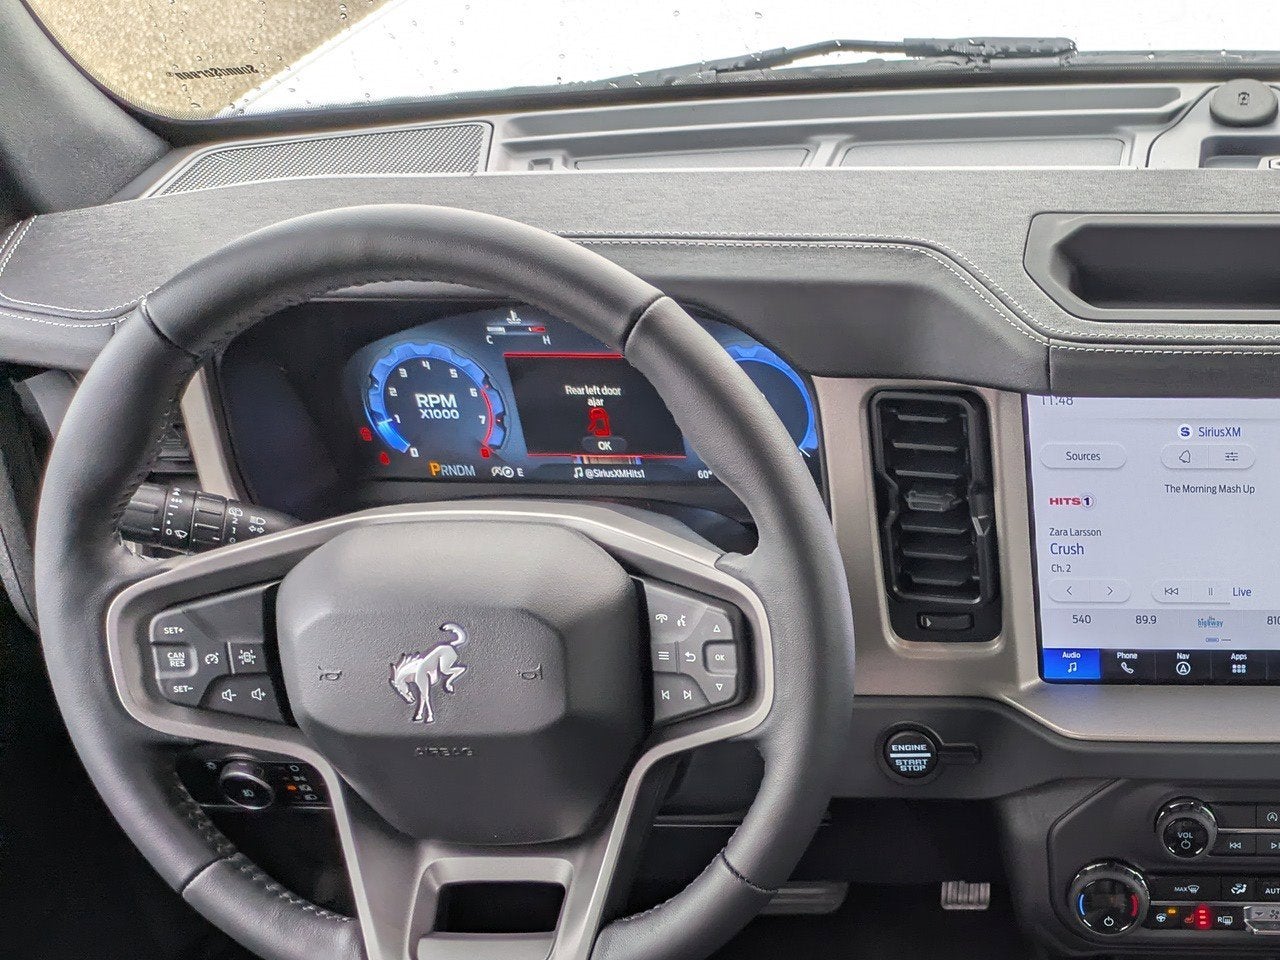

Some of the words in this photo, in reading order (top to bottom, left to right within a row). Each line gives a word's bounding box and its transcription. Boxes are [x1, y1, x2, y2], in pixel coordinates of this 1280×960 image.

[486, 335, 494, 345] C
[542, 335, 552, 345] H
[421, 360, 431, 370] 4
[399, 368, 408, 378] 3
[449, 368, 458, 378] 5
[388, 386, 398, 397] 2
[469, 387, 478, 398] 6
[564, 385, 585, 396] Rear
[585, 385, 601, 396] left
[601, 385, 621, 396] door
[415, 393, 458, 408] RPM
[587, 397, 604, 407] ajar
[394, 414, 401, 423] 1
[419, 409, 460, 420] X1000
[479, 415, 486, 424] 7
[1198, 426, 1241, 437] SiriusXM
[597, 441, 612, 451] OK
[1065, 451, 1101, 462] Sources
[517, 468, 525, 477] E
[1165, 484, 1181, 494] The
[1182, 484, 1217, 496] Morning
[1218, 484, 1241, 494] Mash
[1242, 485, 1256, 496] Up
[1049, 497, 1081, 506] HITS
[1049, 527, 1068, 537] Zara
[1069, 527, 1102, 537] Larsson
[1050, 542, 1085, 555] Crush
[1051, 564, 1065, 573] Ch.
[1065, 564, 1072, 573] 2
[1232, 587, 1252, 597] Live
[1072, 614, 1092, 624] 540
[1135, 614, 1157, 625] 89.9
[715, 653, 726, 661] OK
[1062, 651, 1081, 659] Audio
[1116, 652, 1138, 660] Phone
[1176, 652, 1190, 660] Nav
[1230, 653, 1247, 662] Apps
